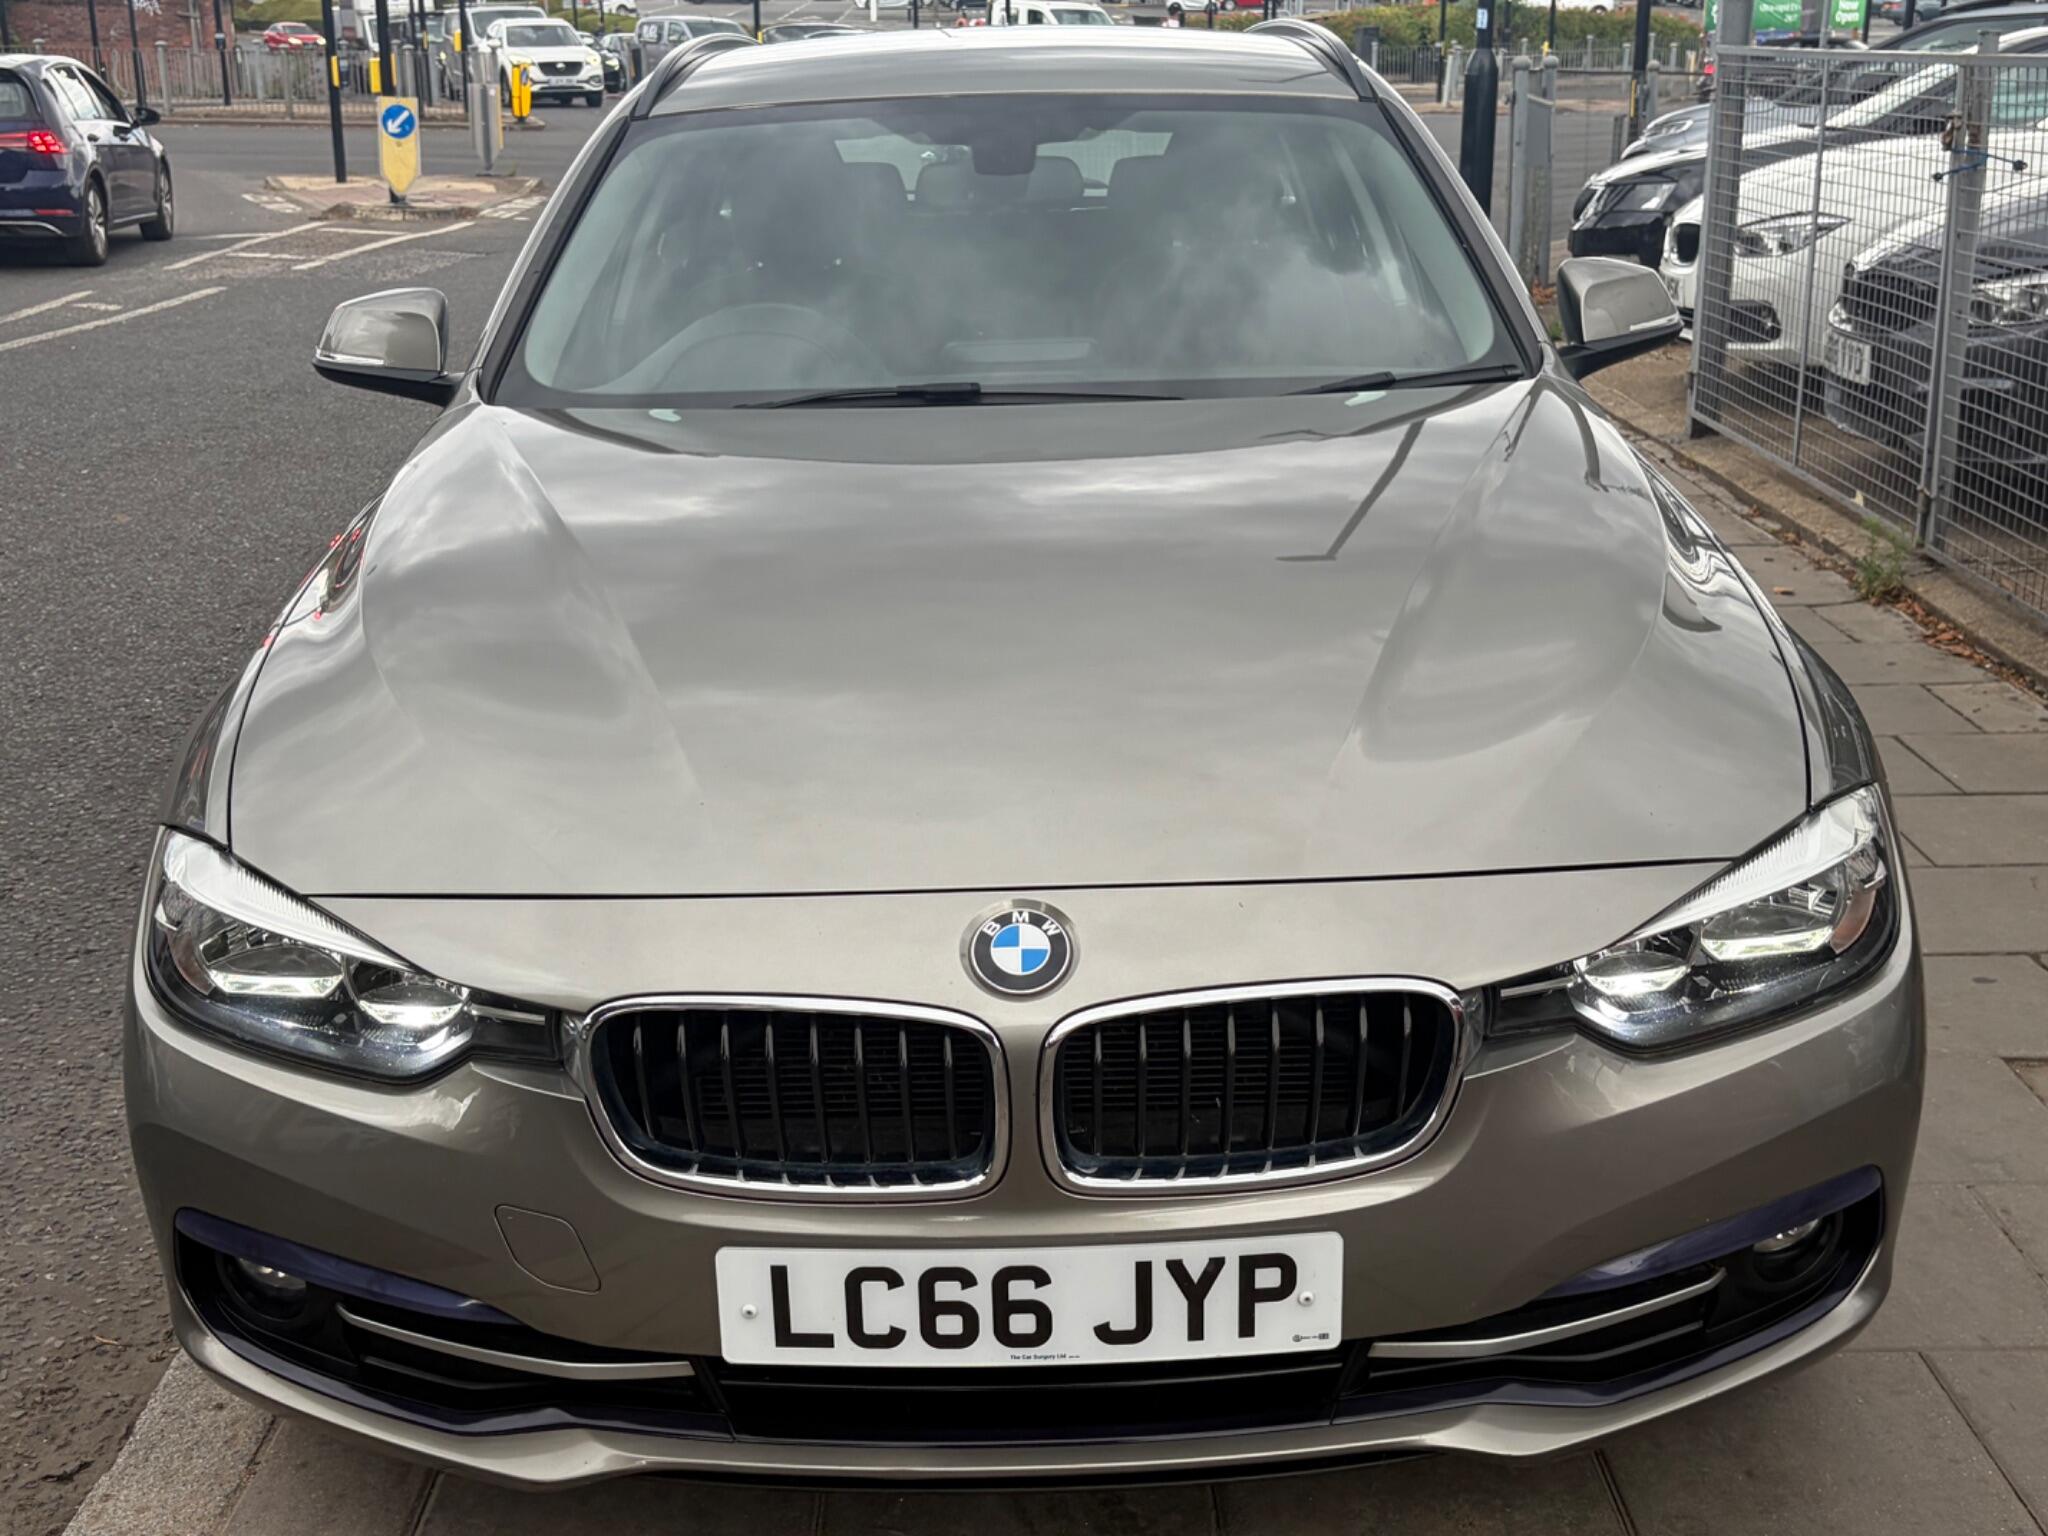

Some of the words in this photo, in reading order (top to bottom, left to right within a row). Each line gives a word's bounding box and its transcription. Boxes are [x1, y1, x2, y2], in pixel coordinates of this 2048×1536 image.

[1838, 0, 1859, 10] New
[1835, 11, 1860, 25] Open
[982, 910, 1061, 937] BMW
[770, 1265, 1053, 1349] LC66
[1093, 1252, 1298, 1346] JYP
